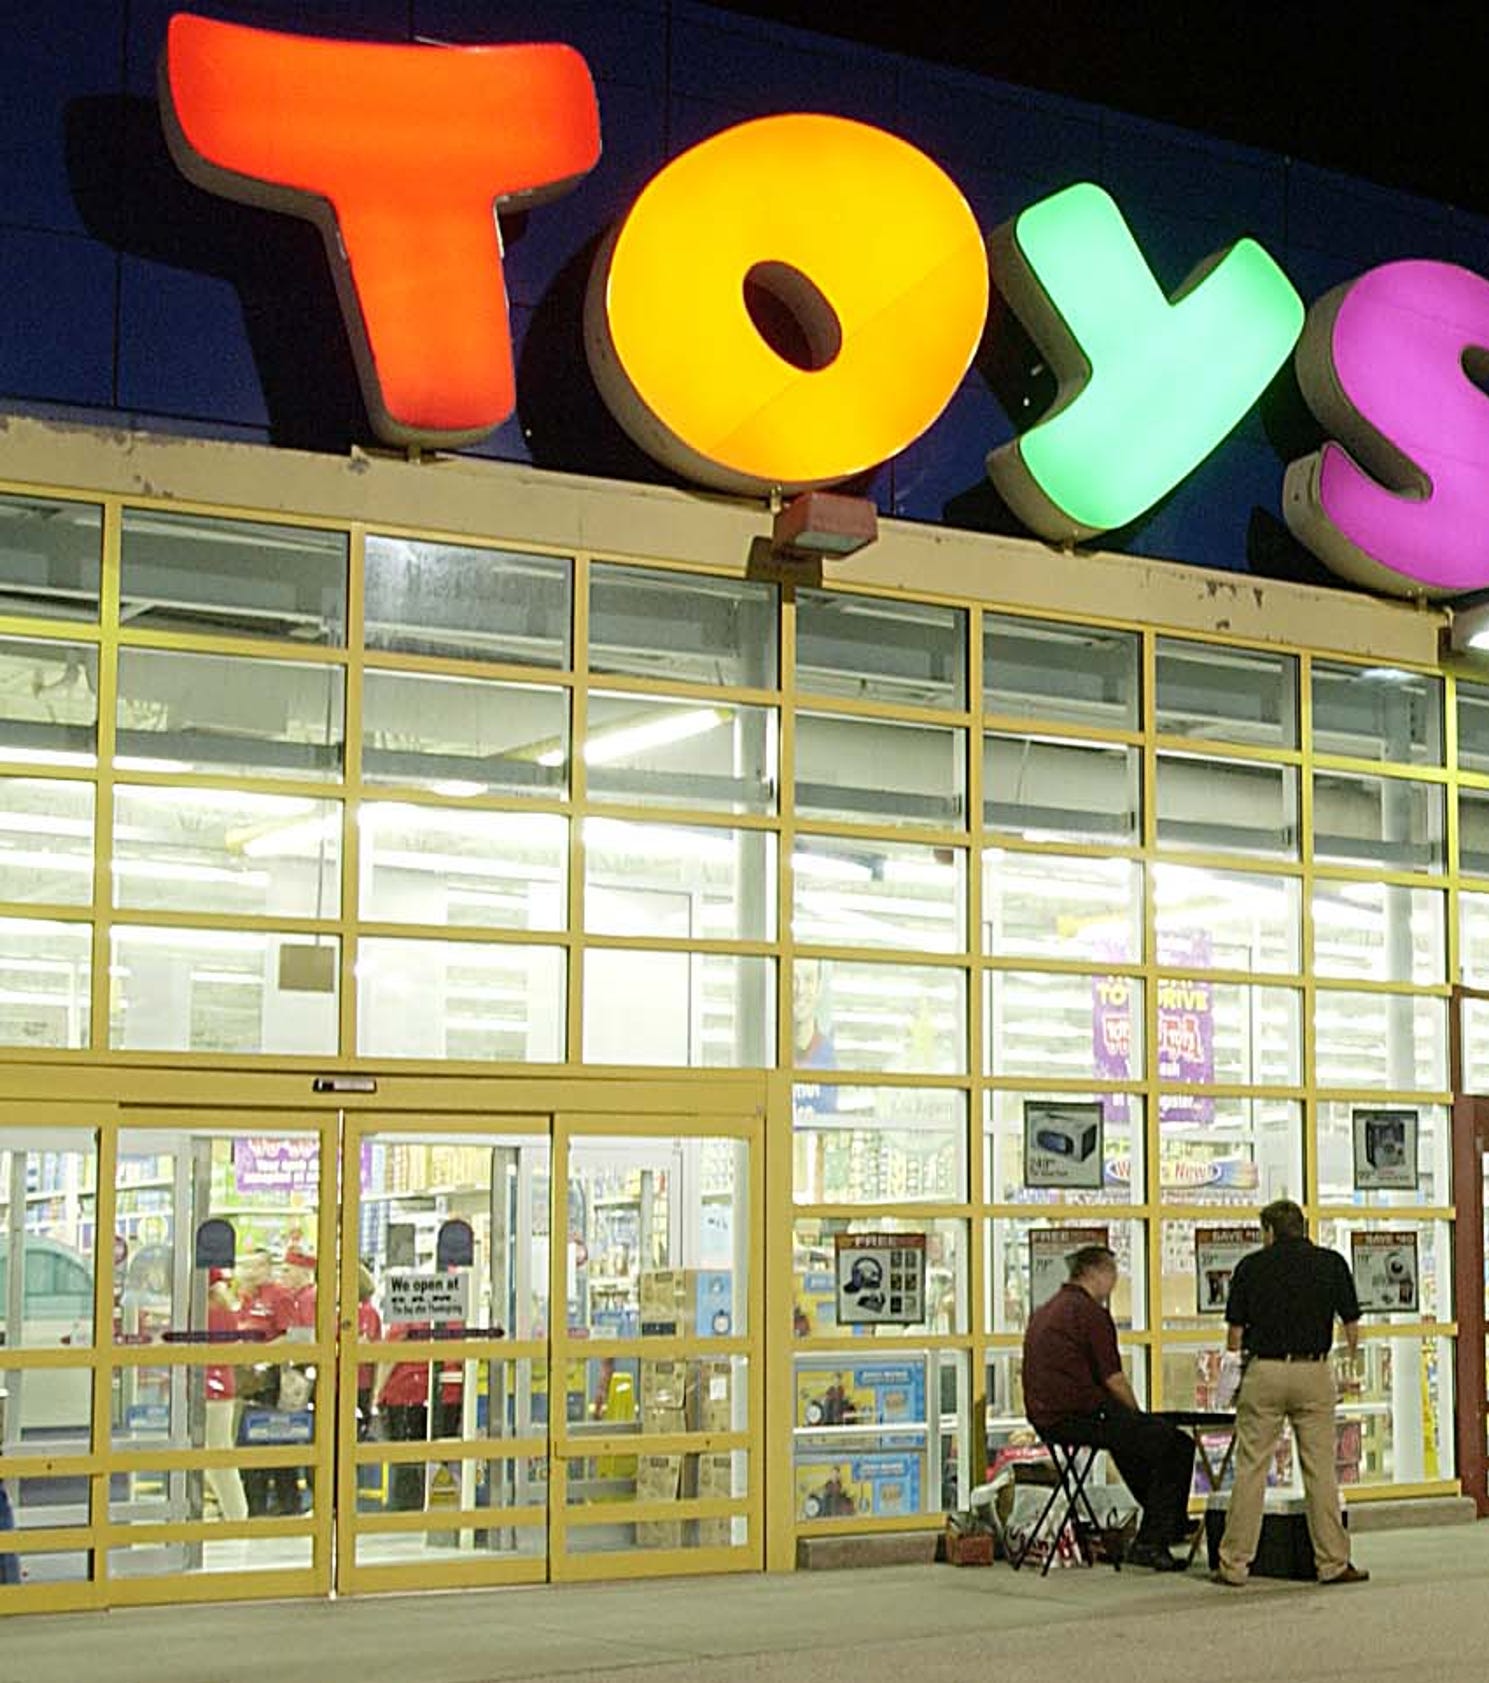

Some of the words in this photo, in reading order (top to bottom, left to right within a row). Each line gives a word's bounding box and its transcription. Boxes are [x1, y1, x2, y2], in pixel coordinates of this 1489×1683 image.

[854, 1235, 896, 1247] FREE
[391, 1276, 410, 1293] We
[412, 1280, 443, 1295] open
[447, 1277, 460, 1291] at
